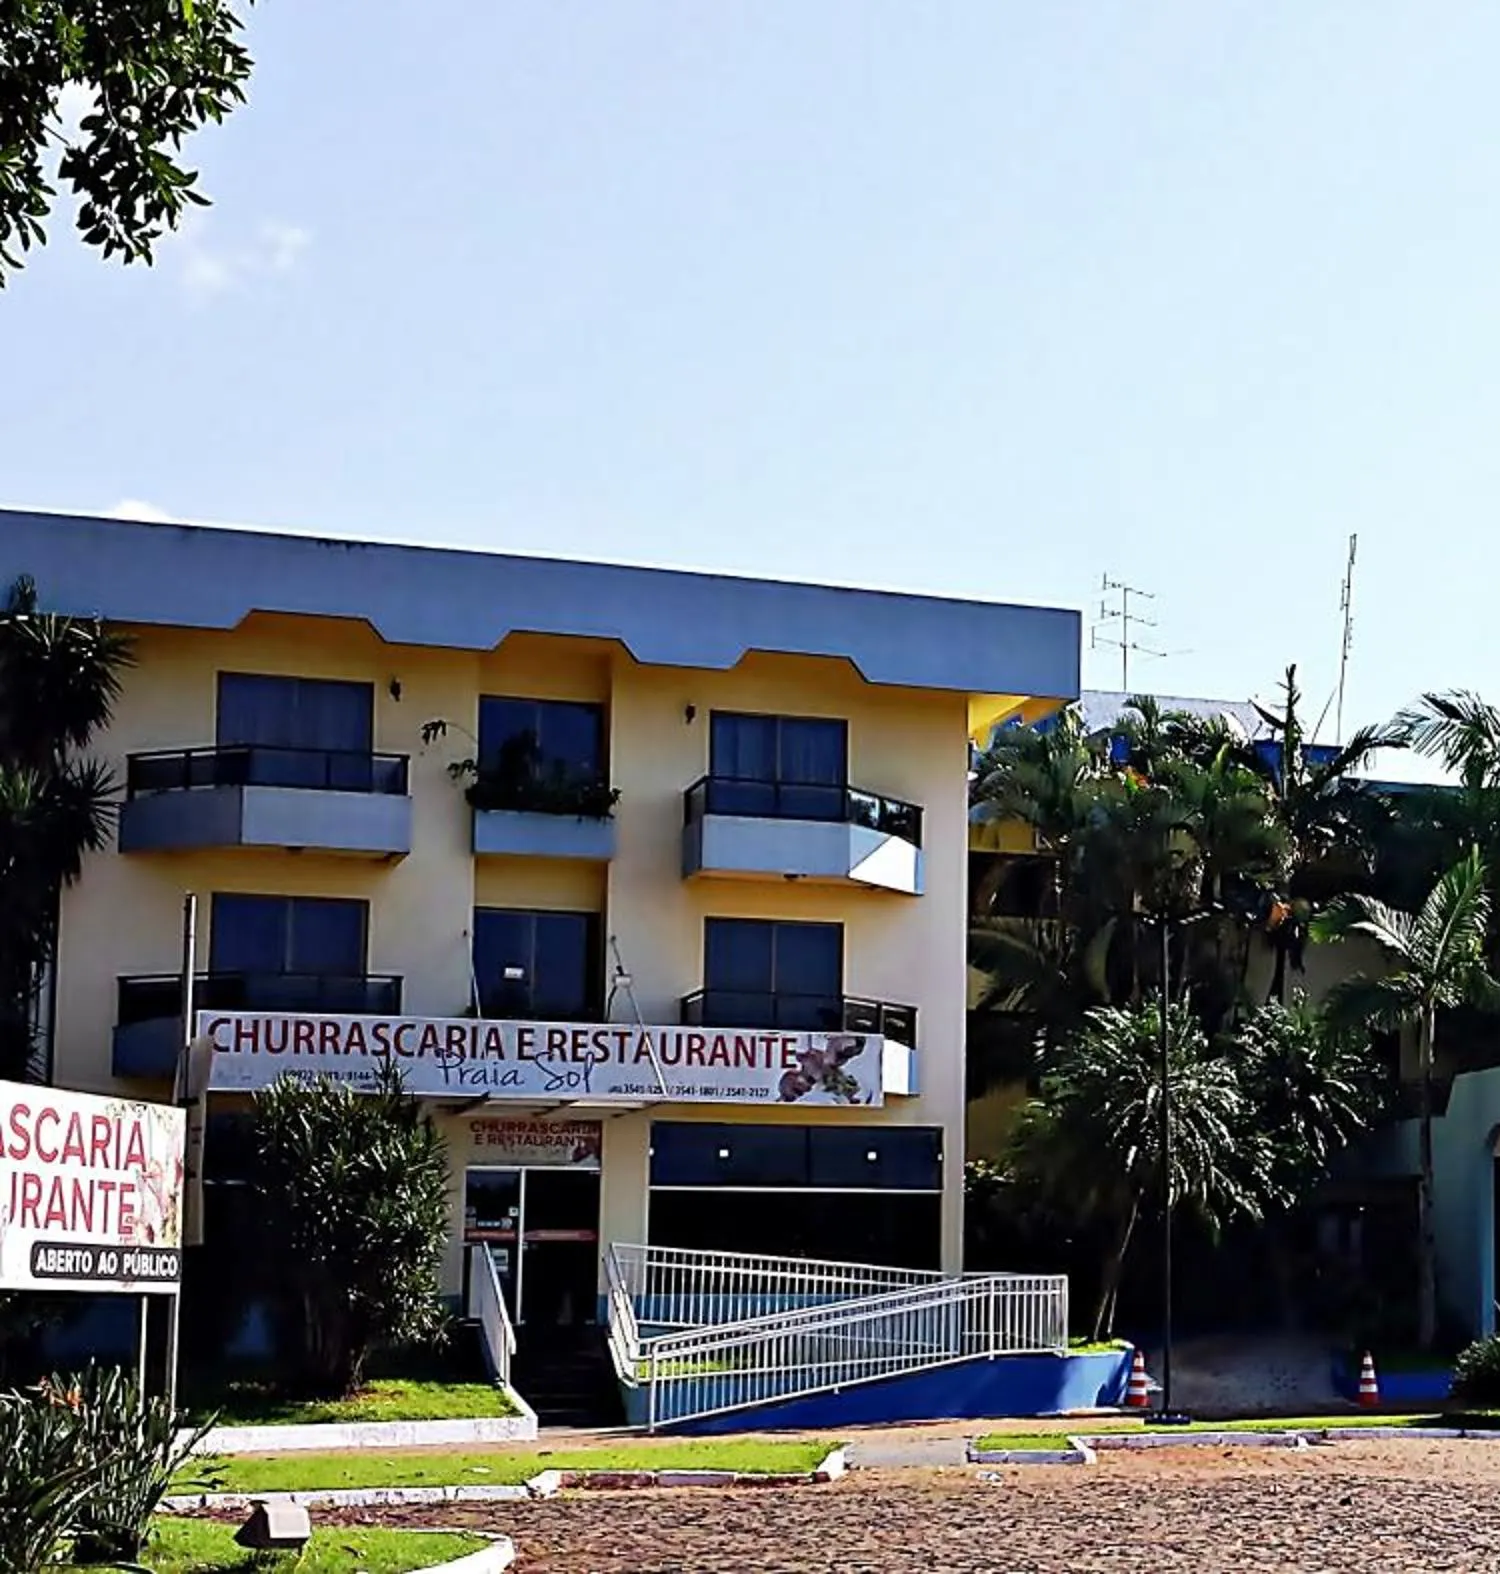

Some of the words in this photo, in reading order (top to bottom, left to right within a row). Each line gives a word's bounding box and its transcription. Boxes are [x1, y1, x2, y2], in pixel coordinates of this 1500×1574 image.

[207, 1017, 505, 1061] CHURRASCARIA
[517, 1027, 535, 1062] E
[547, 1027, 799, 1069] RESTAURANTE
[436, 1048, 525, 1086] Praia
[535, 1051, 595, 1093] Sol
[35, 1248, 93, 1274] ABERTO
[97, 1251, 119, 1275] AO
[123, 1248, 179, 1277] PÚBLICO
